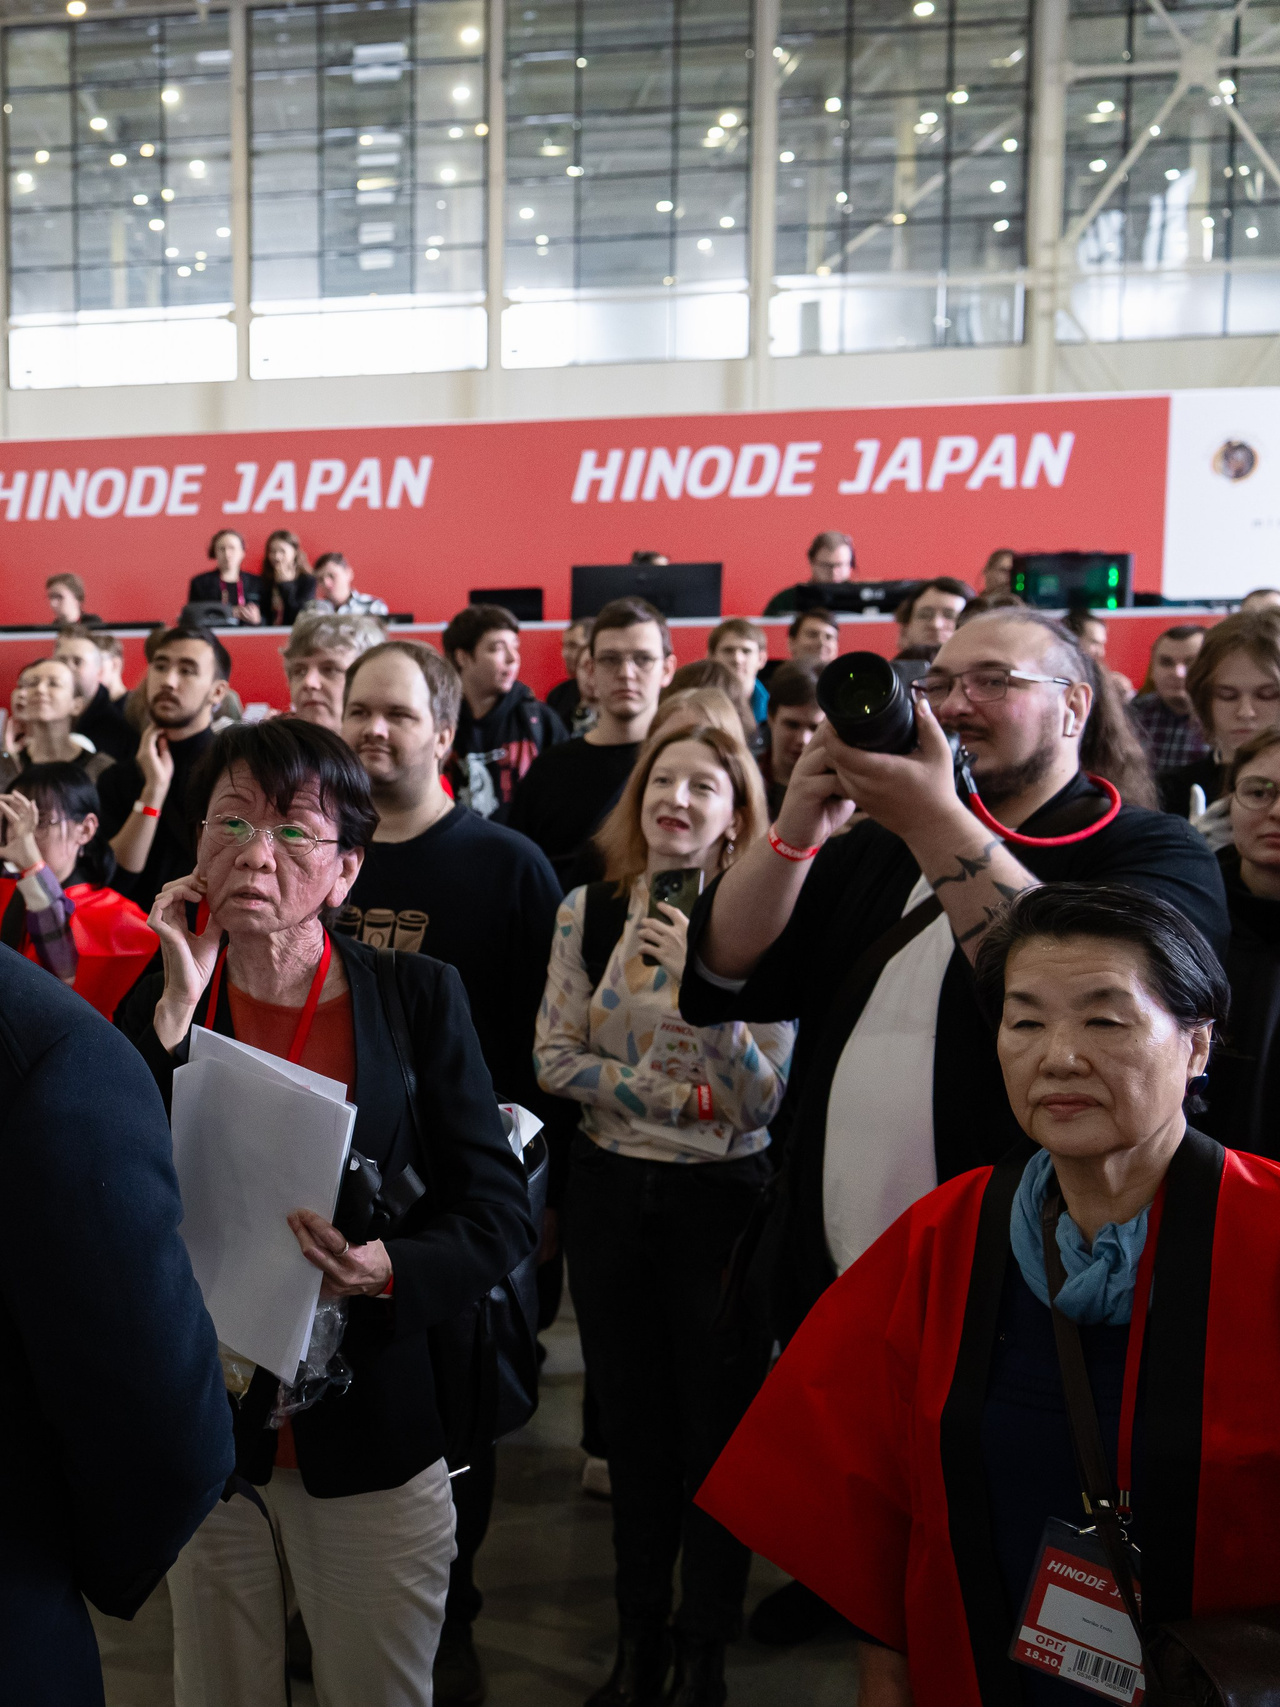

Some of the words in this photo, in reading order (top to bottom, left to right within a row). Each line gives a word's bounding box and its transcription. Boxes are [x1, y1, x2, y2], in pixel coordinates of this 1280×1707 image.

[222, 455, 433, 514] JAPAN
[570, 441, 822, 503] HINODE
[838, 431, 1075, 494] JAPAN
[1047, 1560, 1108, 1591] HINODE
